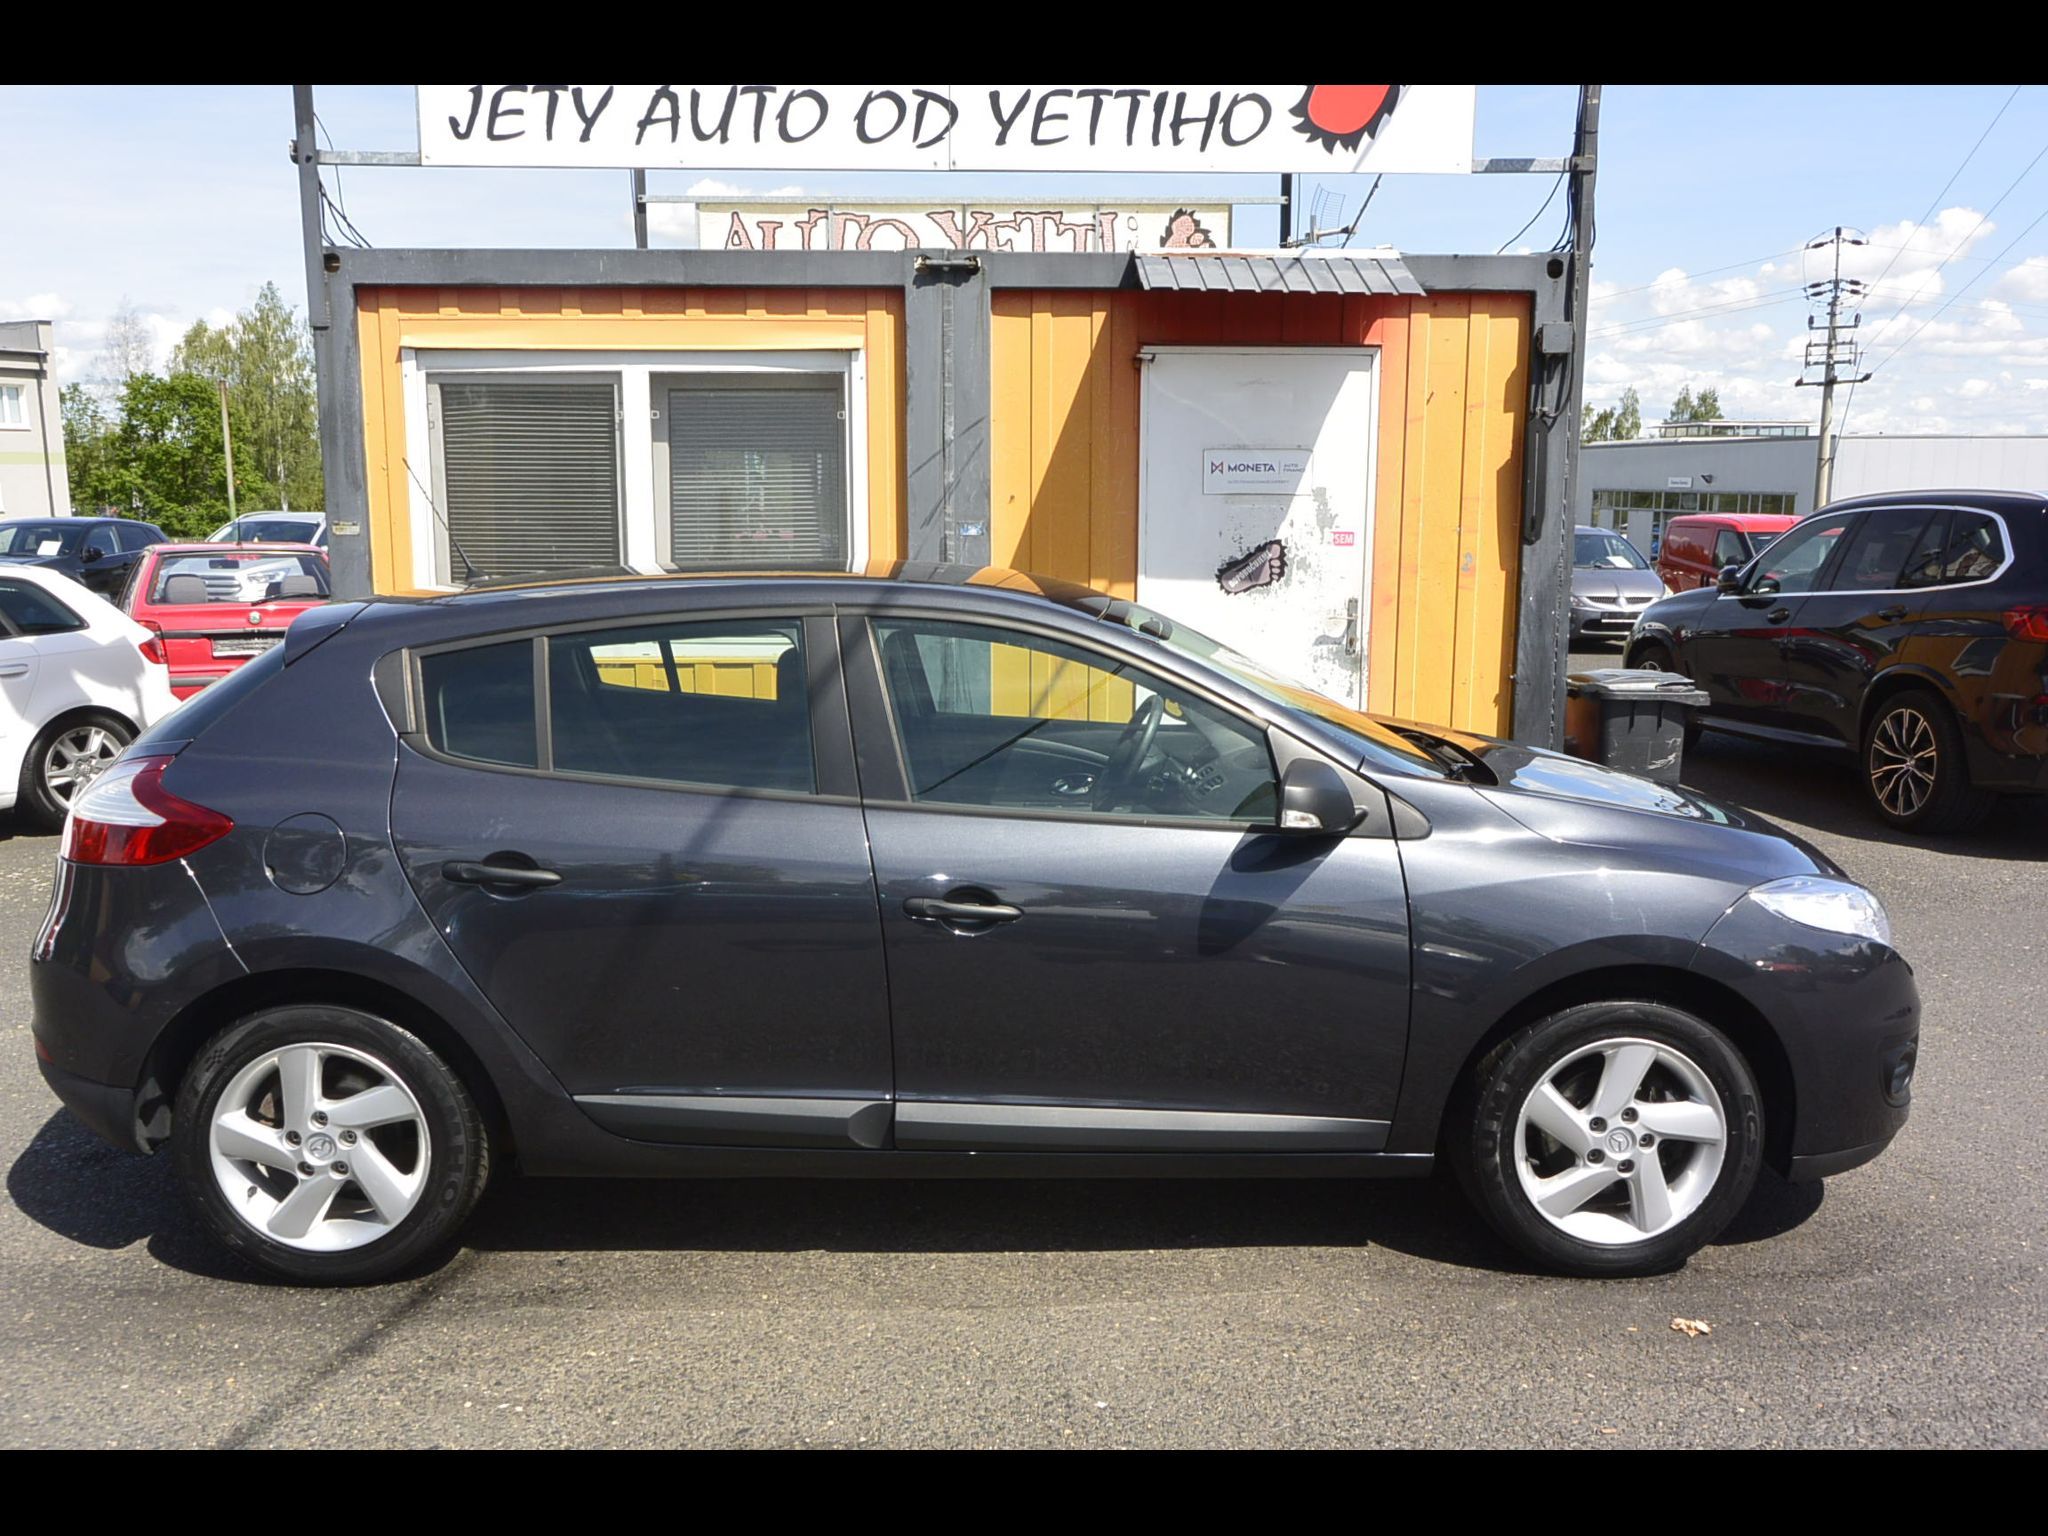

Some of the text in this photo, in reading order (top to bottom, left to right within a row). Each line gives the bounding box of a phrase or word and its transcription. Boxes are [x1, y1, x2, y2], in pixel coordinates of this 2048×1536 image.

[449, 86, 1271, 152] JETY AUTO OD YETTIHO
[1227, 463, 1276, 473] MONETA
